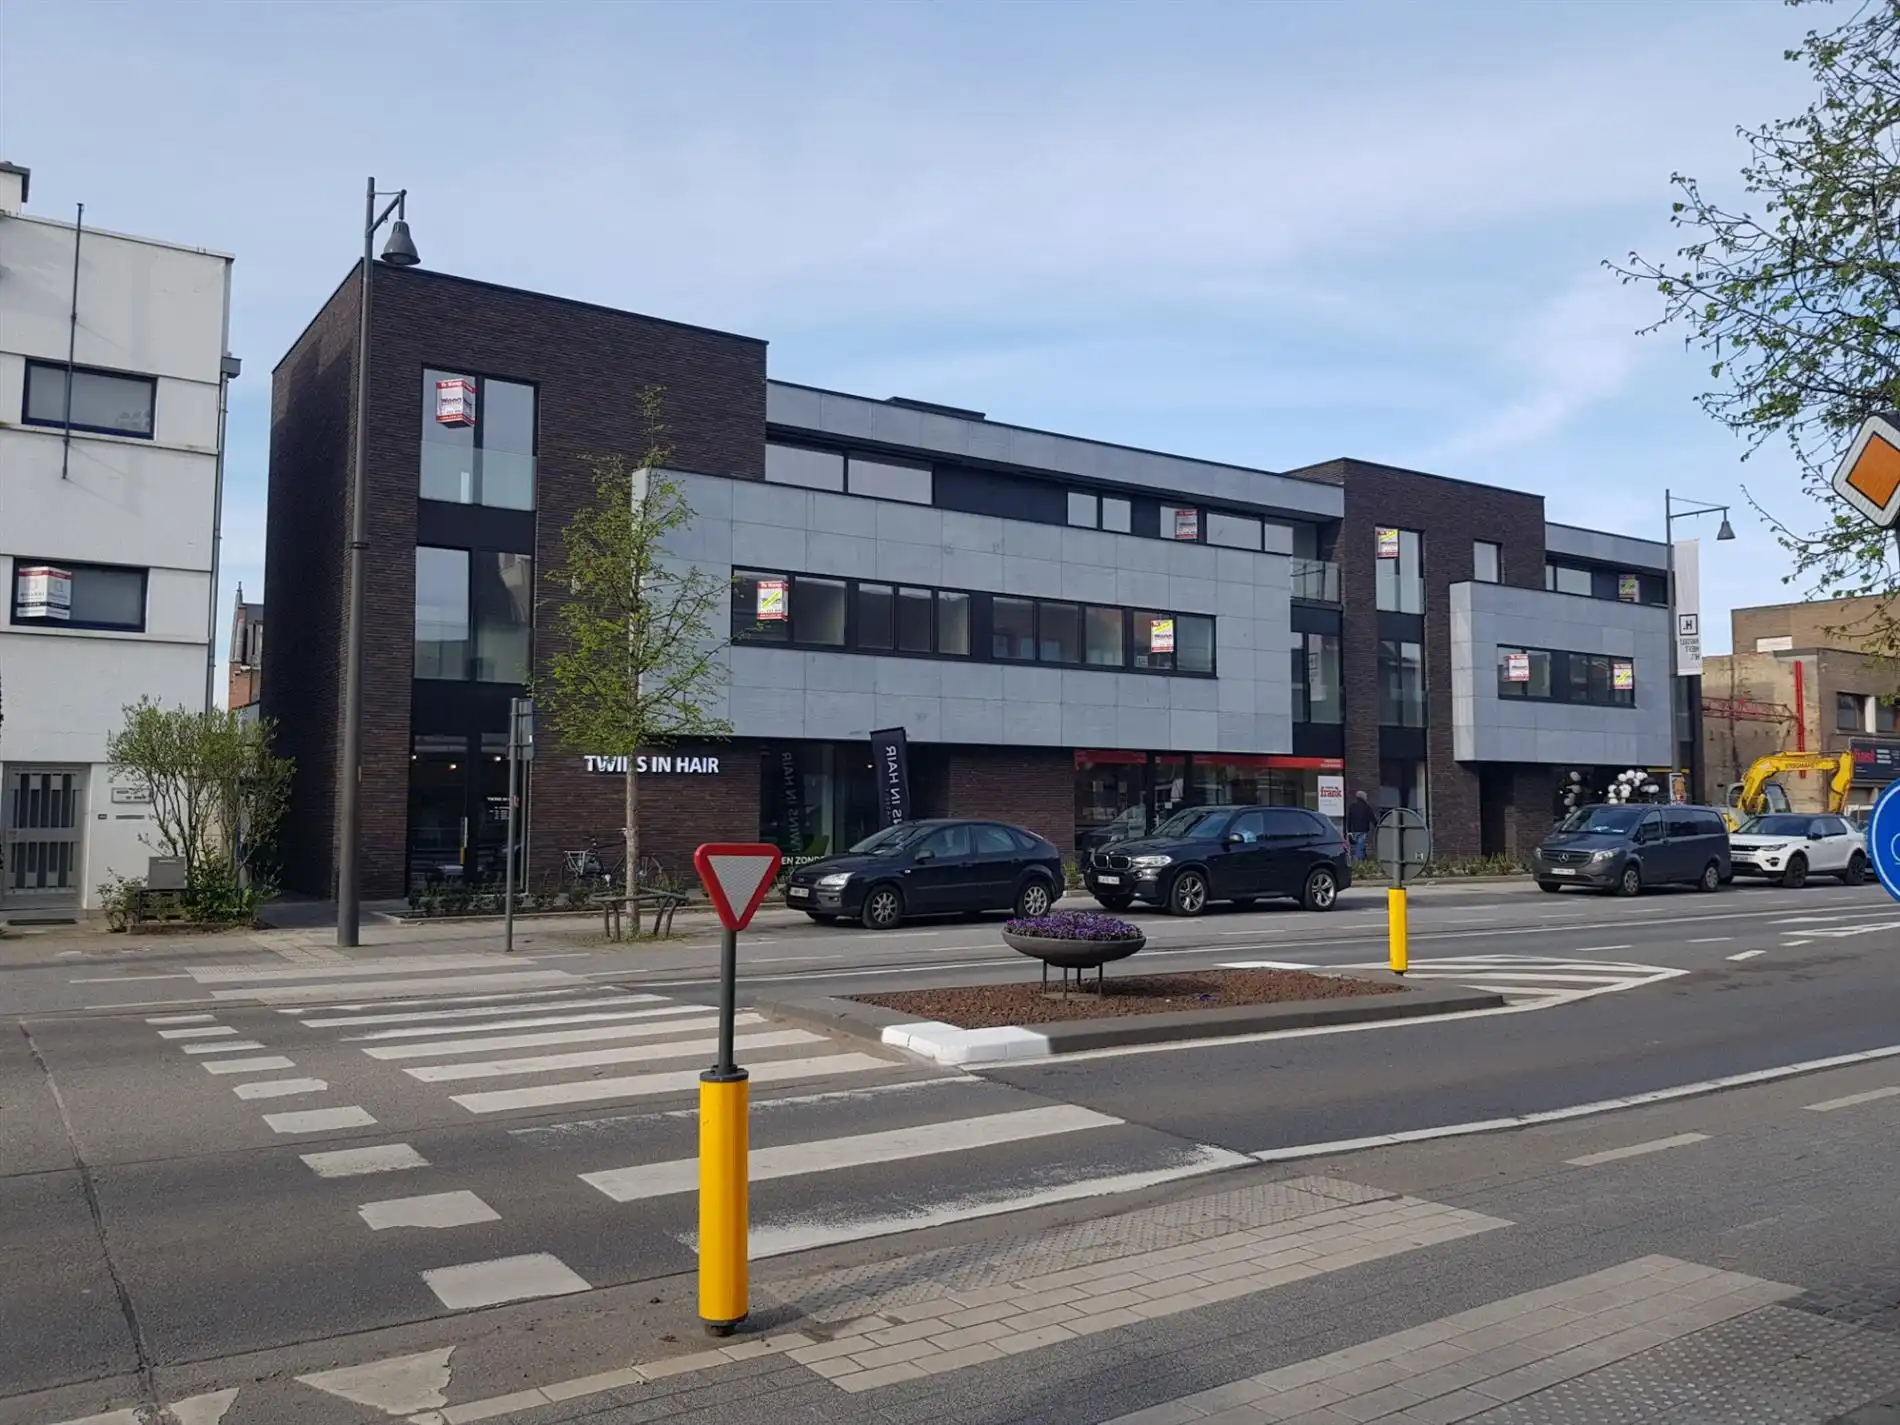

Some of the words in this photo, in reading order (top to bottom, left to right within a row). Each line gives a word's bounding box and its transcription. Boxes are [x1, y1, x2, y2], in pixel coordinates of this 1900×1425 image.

[652, 756, 672, 773] IN
[676, 756, 720, 774] HAIR
[782, 856, 794, 867] EN
